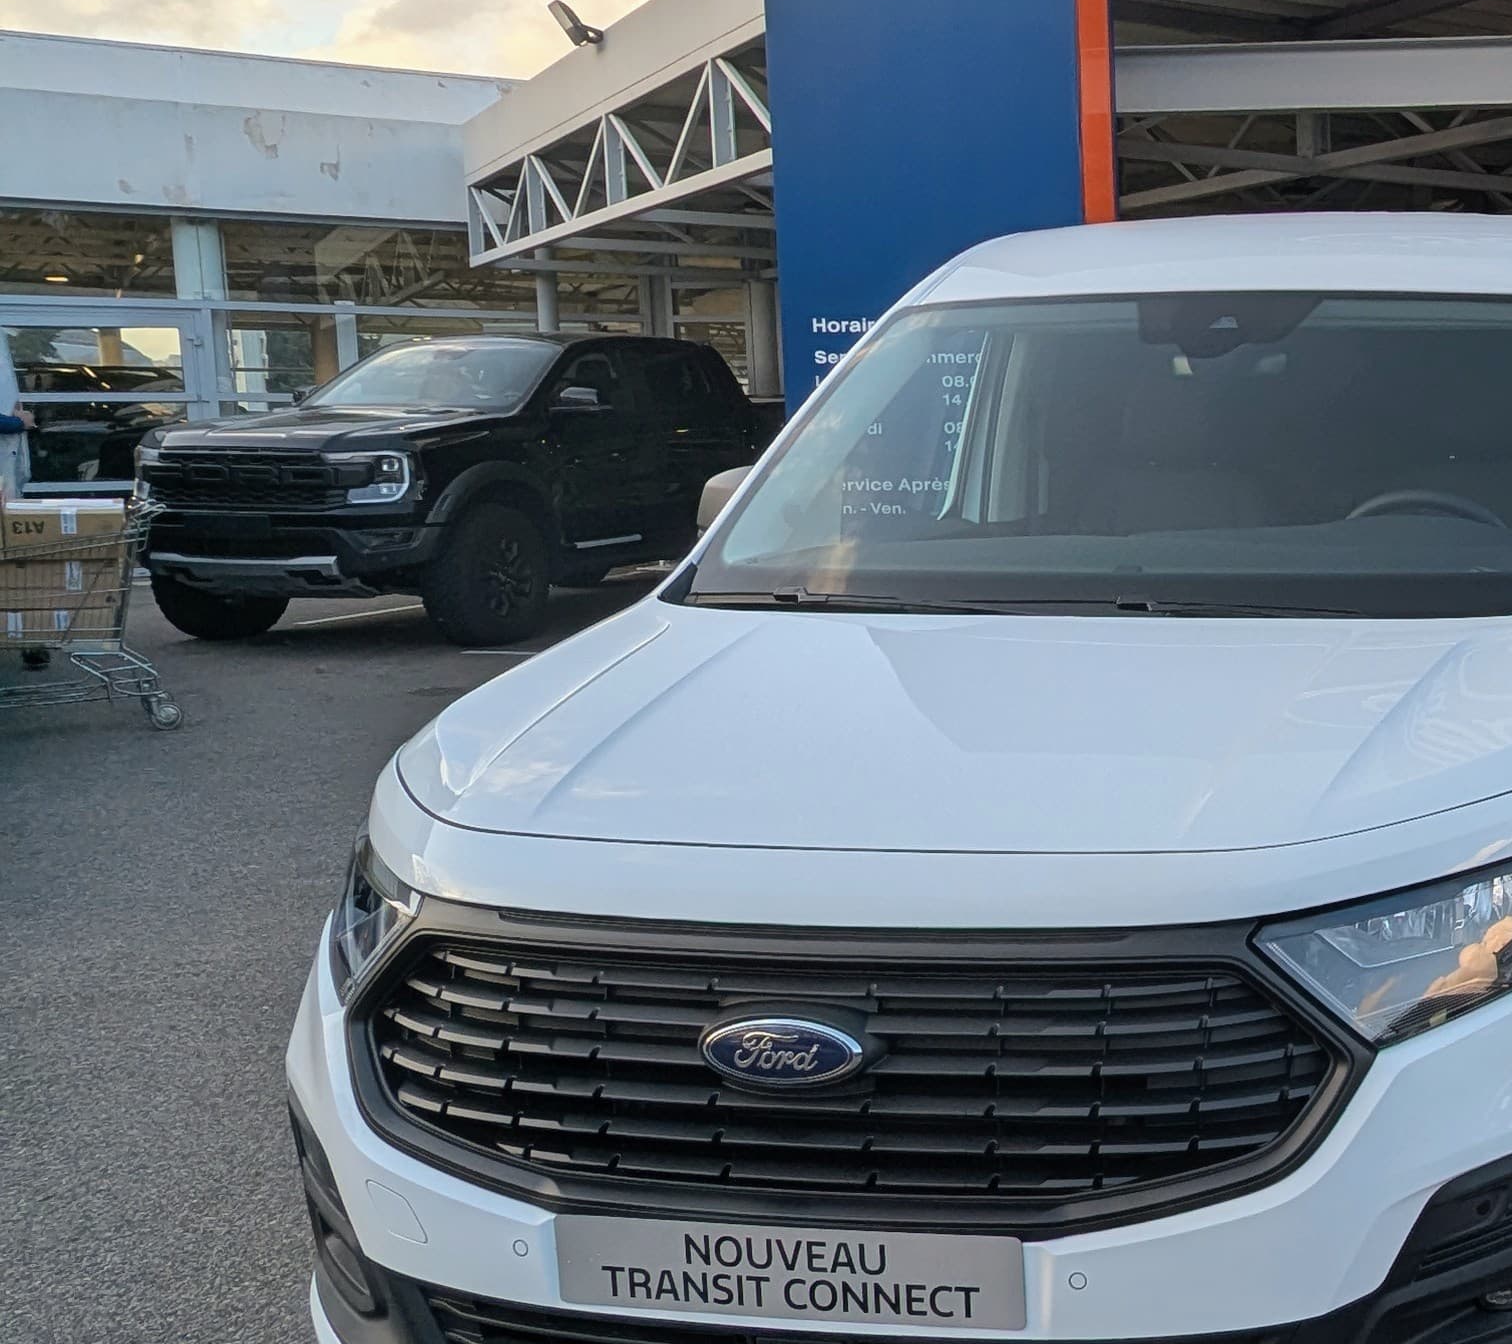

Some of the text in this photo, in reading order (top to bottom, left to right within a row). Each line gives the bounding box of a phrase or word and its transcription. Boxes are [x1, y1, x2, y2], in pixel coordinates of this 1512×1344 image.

[12, 520, 45, 535] A13
[870, 503, 906, 515] Ven.
[734, 1031, 820, 1071] Ford
[684, 1232, 887, 1276] NOUVEAU
[601, 1265, 981, 1319] TRANSIT CONNECT
